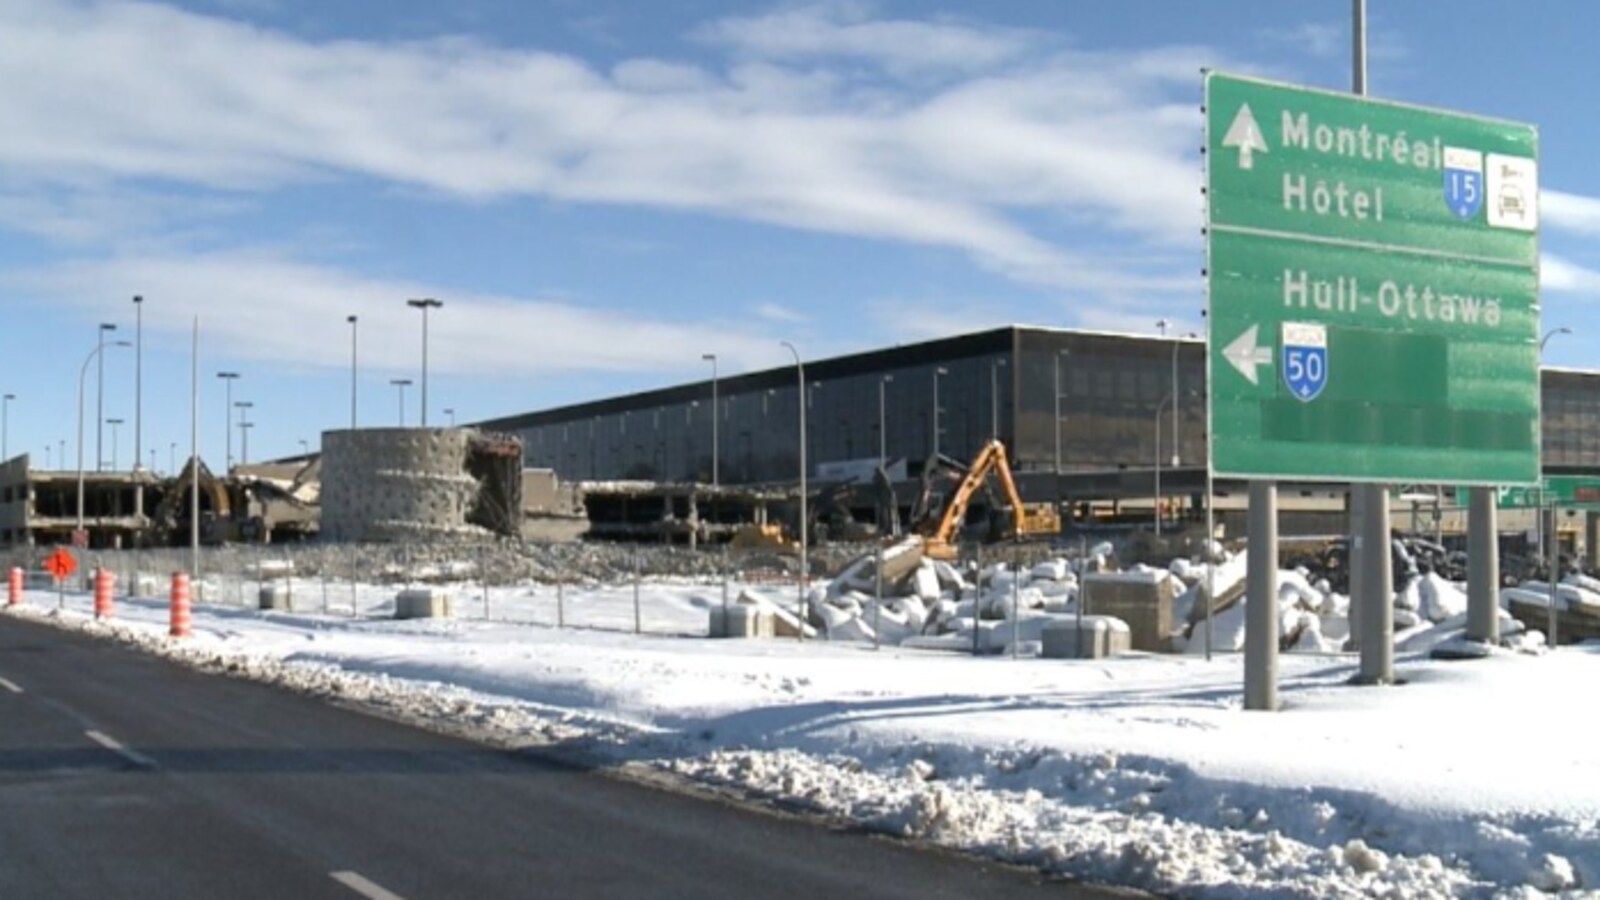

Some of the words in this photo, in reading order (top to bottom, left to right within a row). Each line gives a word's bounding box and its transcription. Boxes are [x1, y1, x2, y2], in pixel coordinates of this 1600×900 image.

[1281, 109, 1440, 170] Montréal
[1282, 172, 1383, 222] Hôtel
[1451, 172, 1476, 203] 15
[1284, 268, 1501, 327] Hull-Ottawa
[1288, 351, 1322, 382] 50
